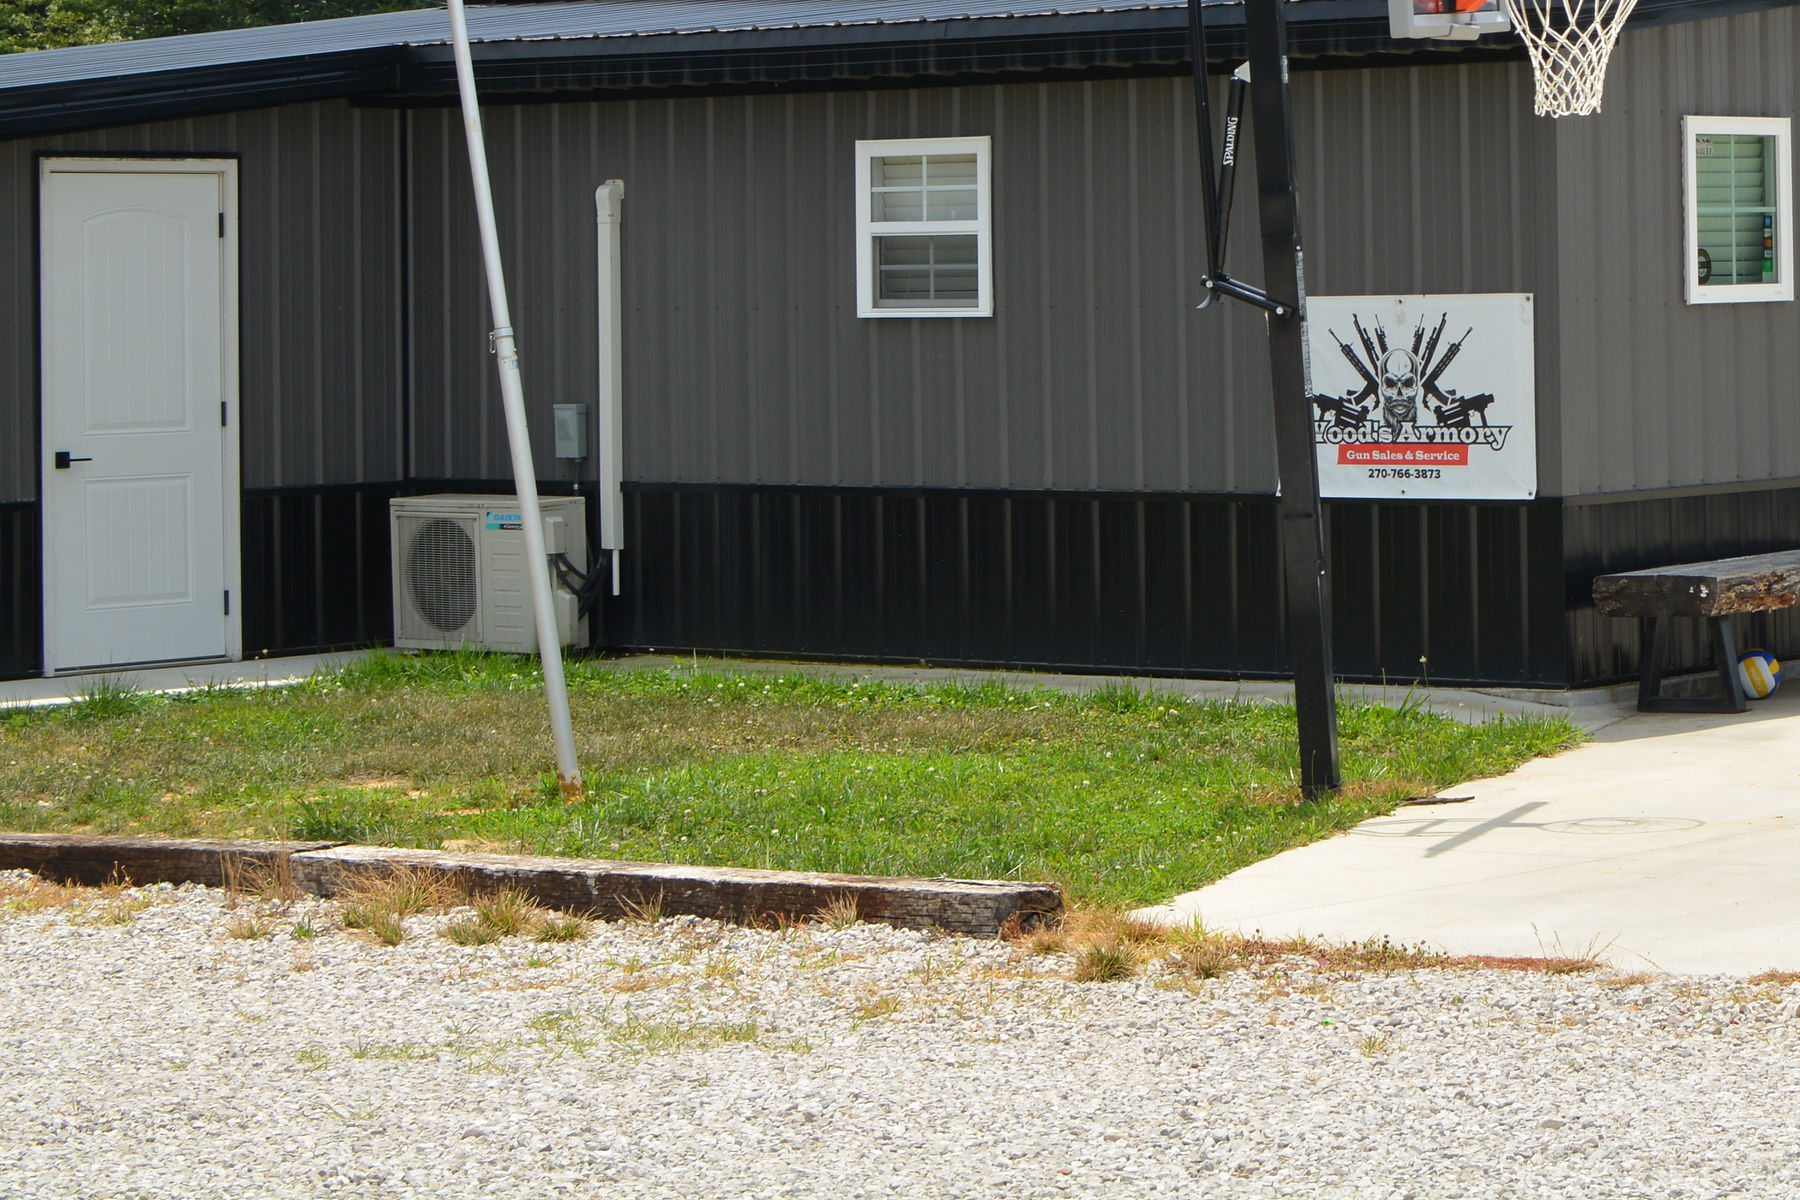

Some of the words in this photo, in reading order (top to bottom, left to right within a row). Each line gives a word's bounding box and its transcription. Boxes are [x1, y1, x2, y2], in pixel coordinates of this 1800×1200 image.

[1223, 116, 1239, 166] SPALDING
[1394, 420, 1514, 452] Armory
[1346, 451, 1370, 461] Gun
[1372, 451, 1403, 461] Sales
[1404, 451, 1414, 461] &
[1415, 451, 1460, 461] Service
[1368, 468, 1441, 479] 270-766-3873
